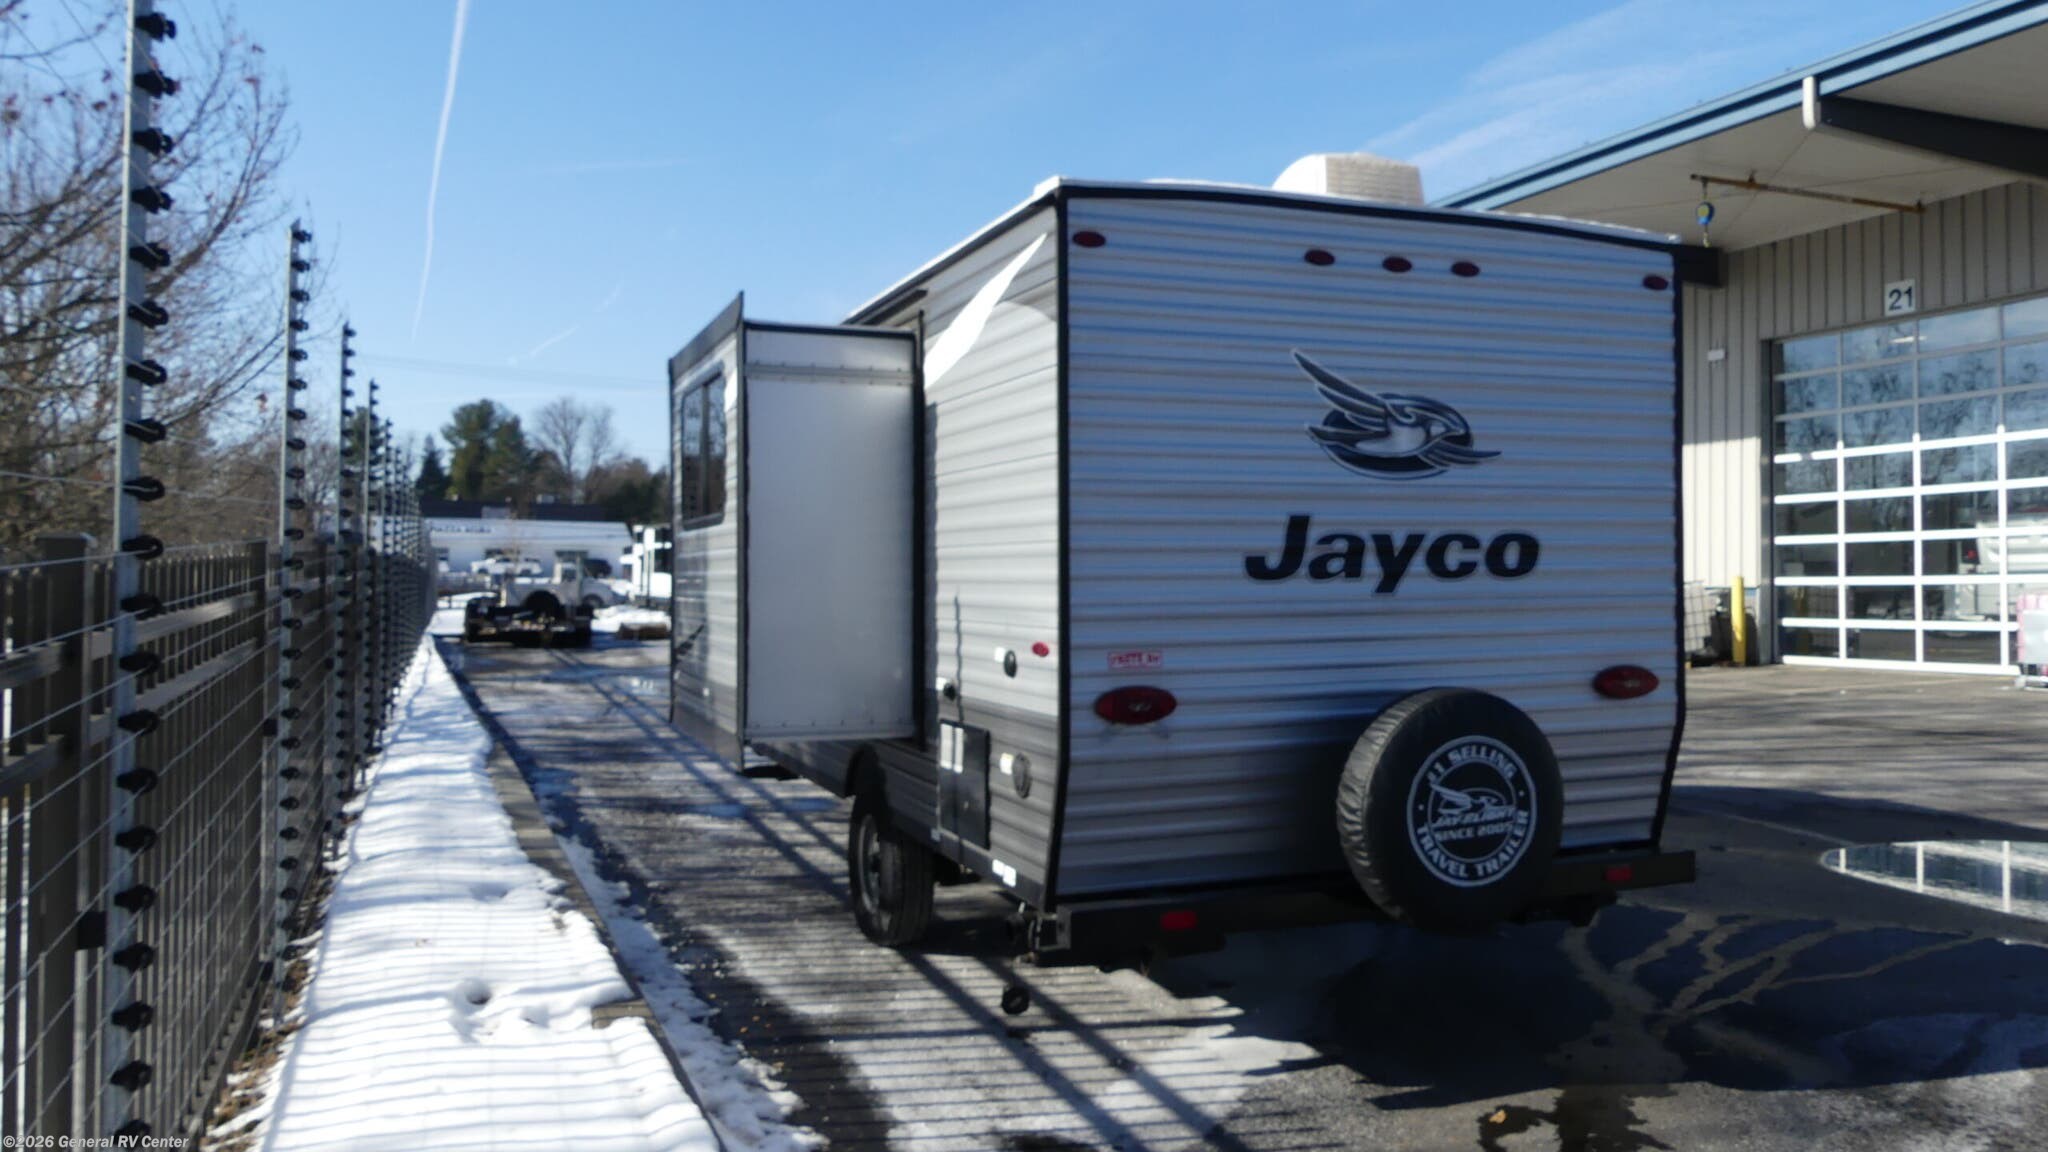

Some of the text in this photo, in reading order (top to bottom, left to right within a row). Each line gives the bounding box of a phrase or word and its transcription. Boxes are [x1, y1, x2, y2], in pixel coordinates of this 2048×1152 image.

[1888, 286, 1912, 311] 21
[1244, 514, 1540, 594] Jayco
[1447, 744, 1518, 778] SELLING
[1416, 809, 1529, 877] TRAVEL TRAILER
[1433, 827, 1474, 842] SINCE
